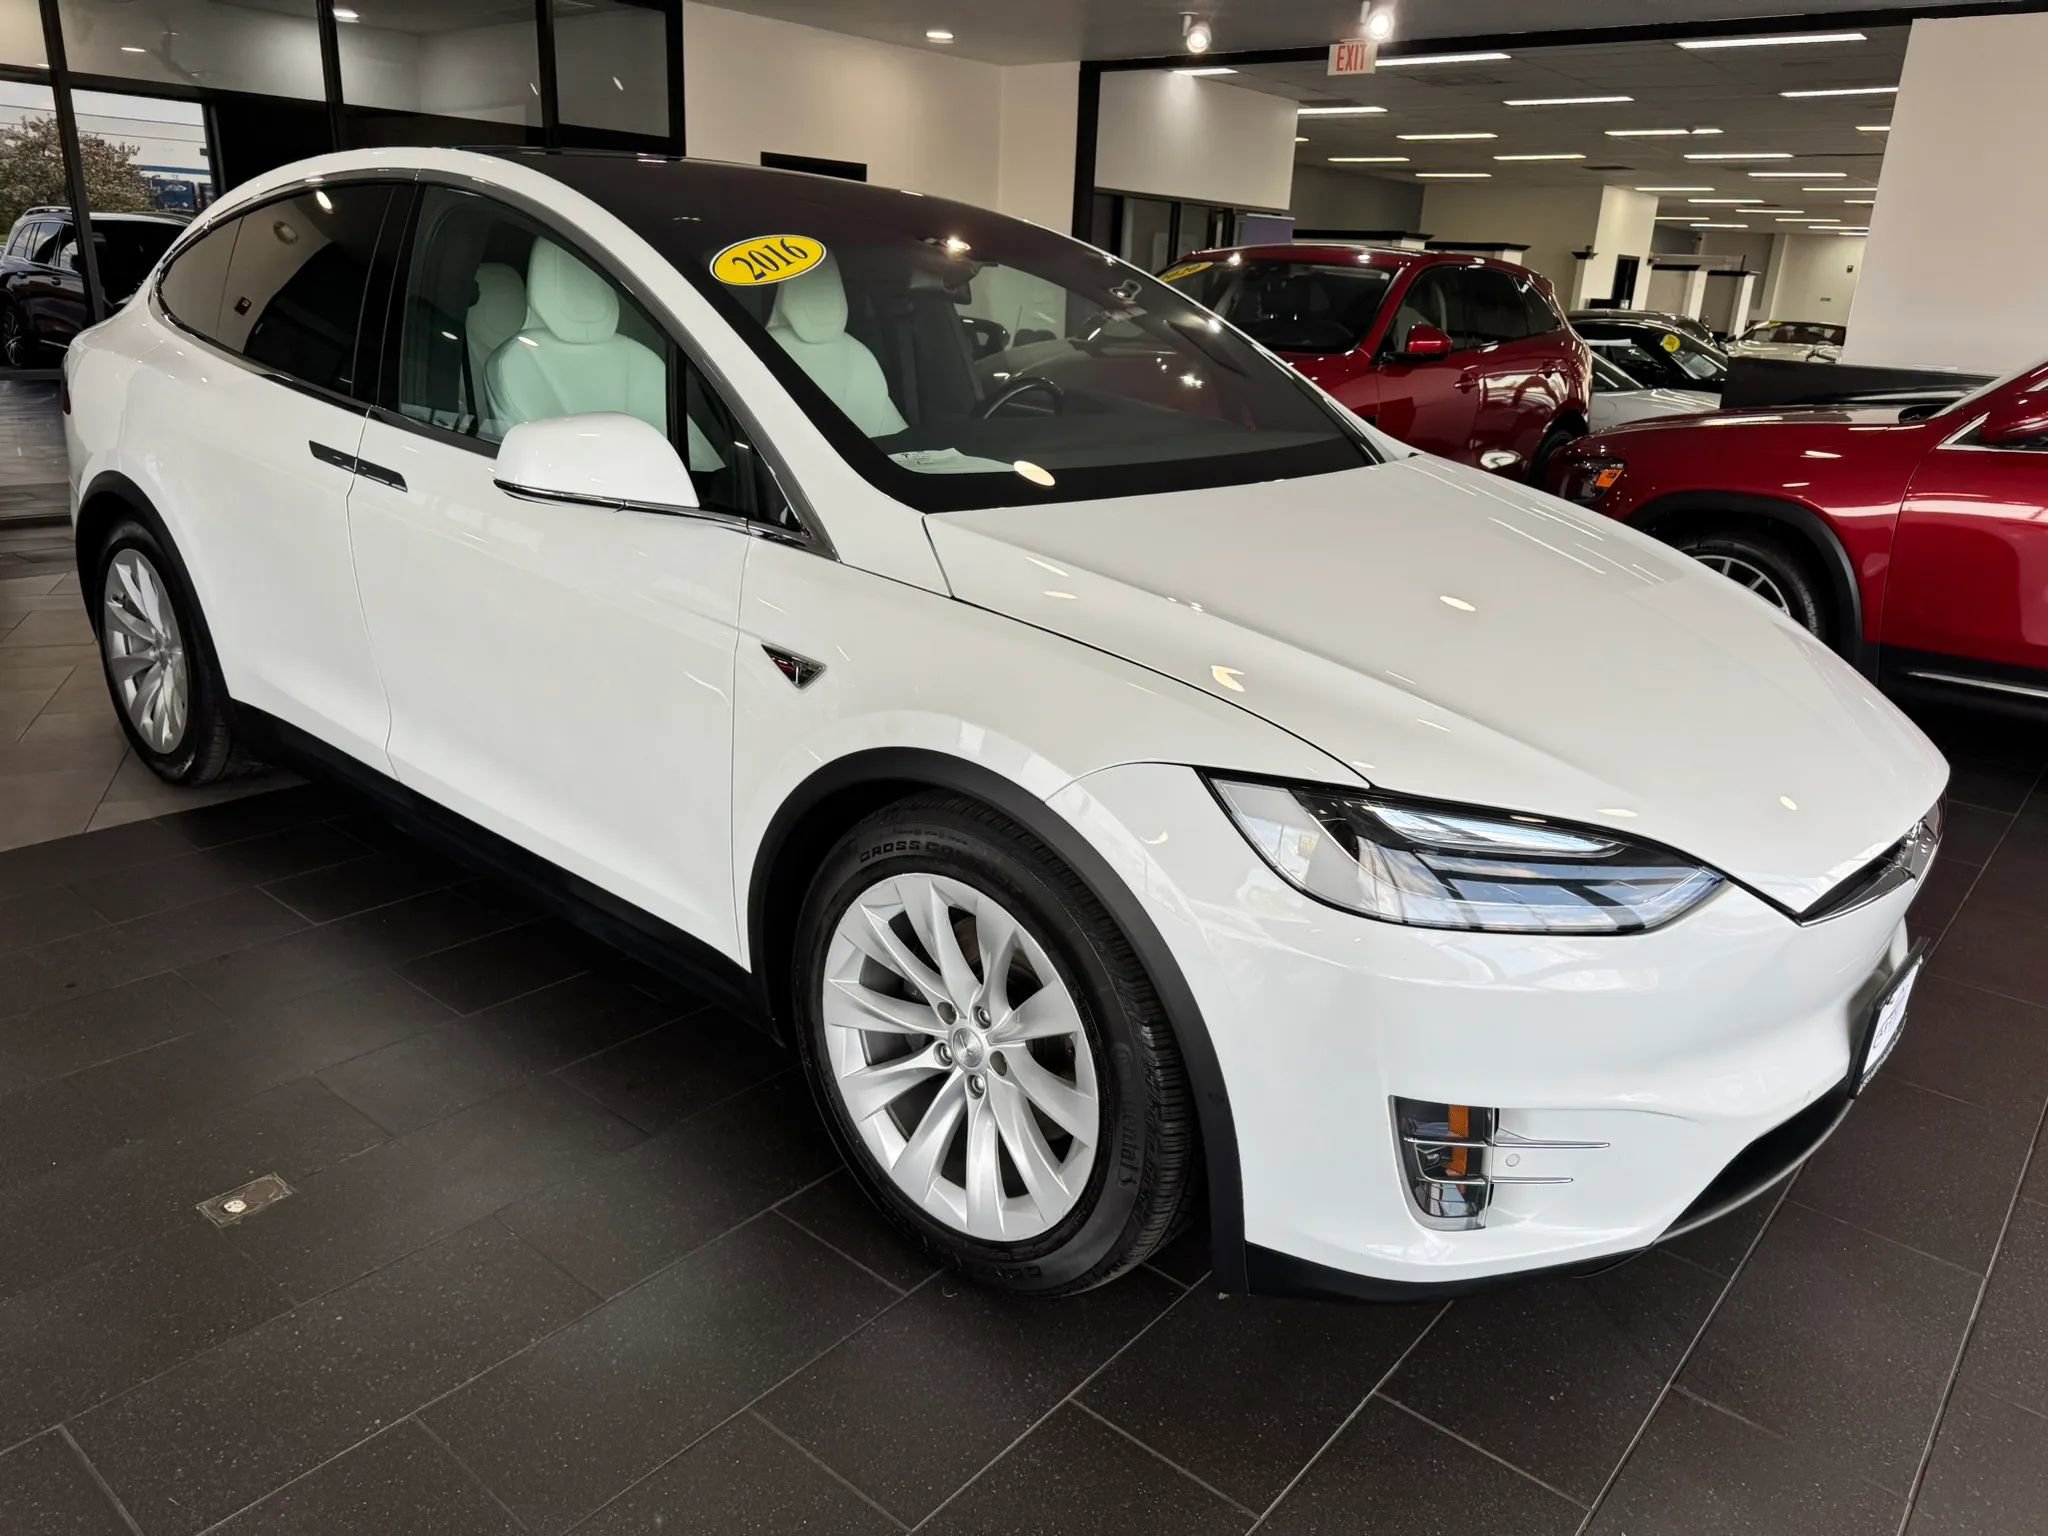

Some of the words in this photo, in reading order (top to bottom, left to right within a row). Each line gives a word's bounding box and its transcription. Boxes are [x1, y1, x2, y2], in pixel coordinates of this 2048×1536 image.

[1336, 44, 1368, 72] EXIT
[731, 237, 808, 281] 2016
[859, 840, 921, 863] CROSS
